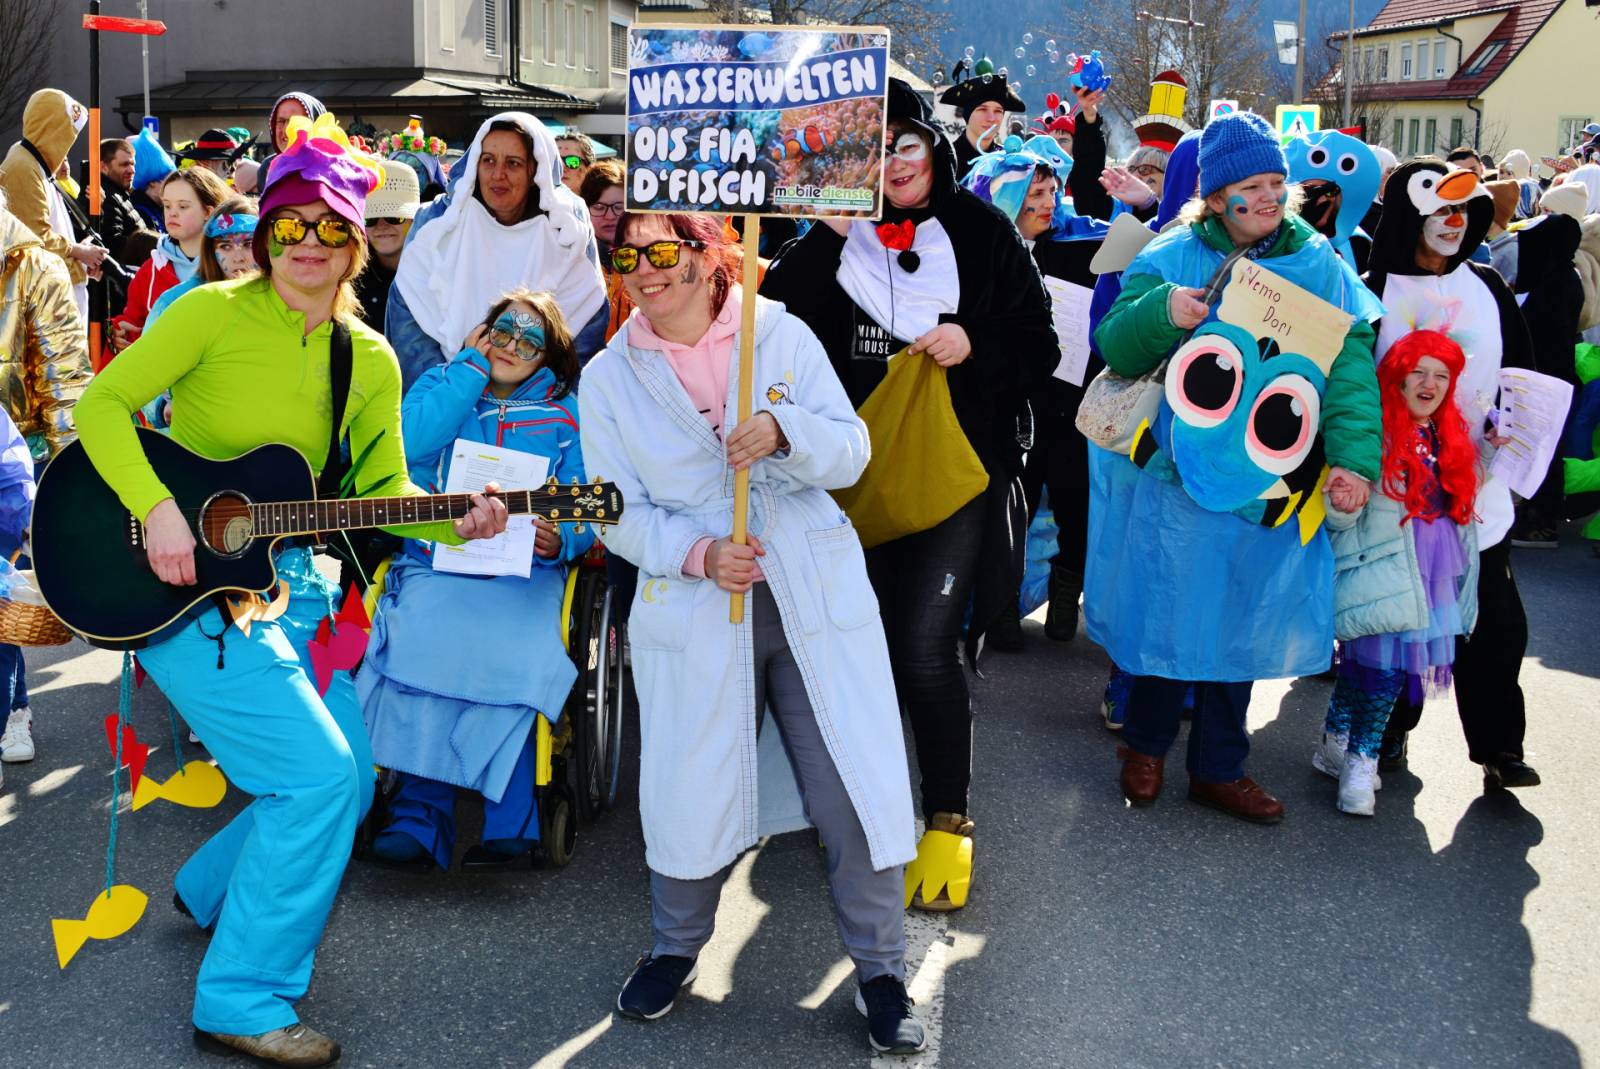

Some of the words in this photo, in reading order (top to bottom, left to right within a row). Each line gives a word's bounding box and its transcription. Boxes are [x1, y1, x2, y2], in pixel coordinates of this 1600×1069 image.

[632, 54, 877, 109] WASSERWELTEN
[634, 126, 688, 161] OIS
[699, 127, 756, 163] FIA
[633, 167, 765, 205] D'FISCH
[775, 185, 873, 199] mobiledienste
[1239, 266, 1281, 303] Nemo
[1263, 306, 1292, 336] Dori
